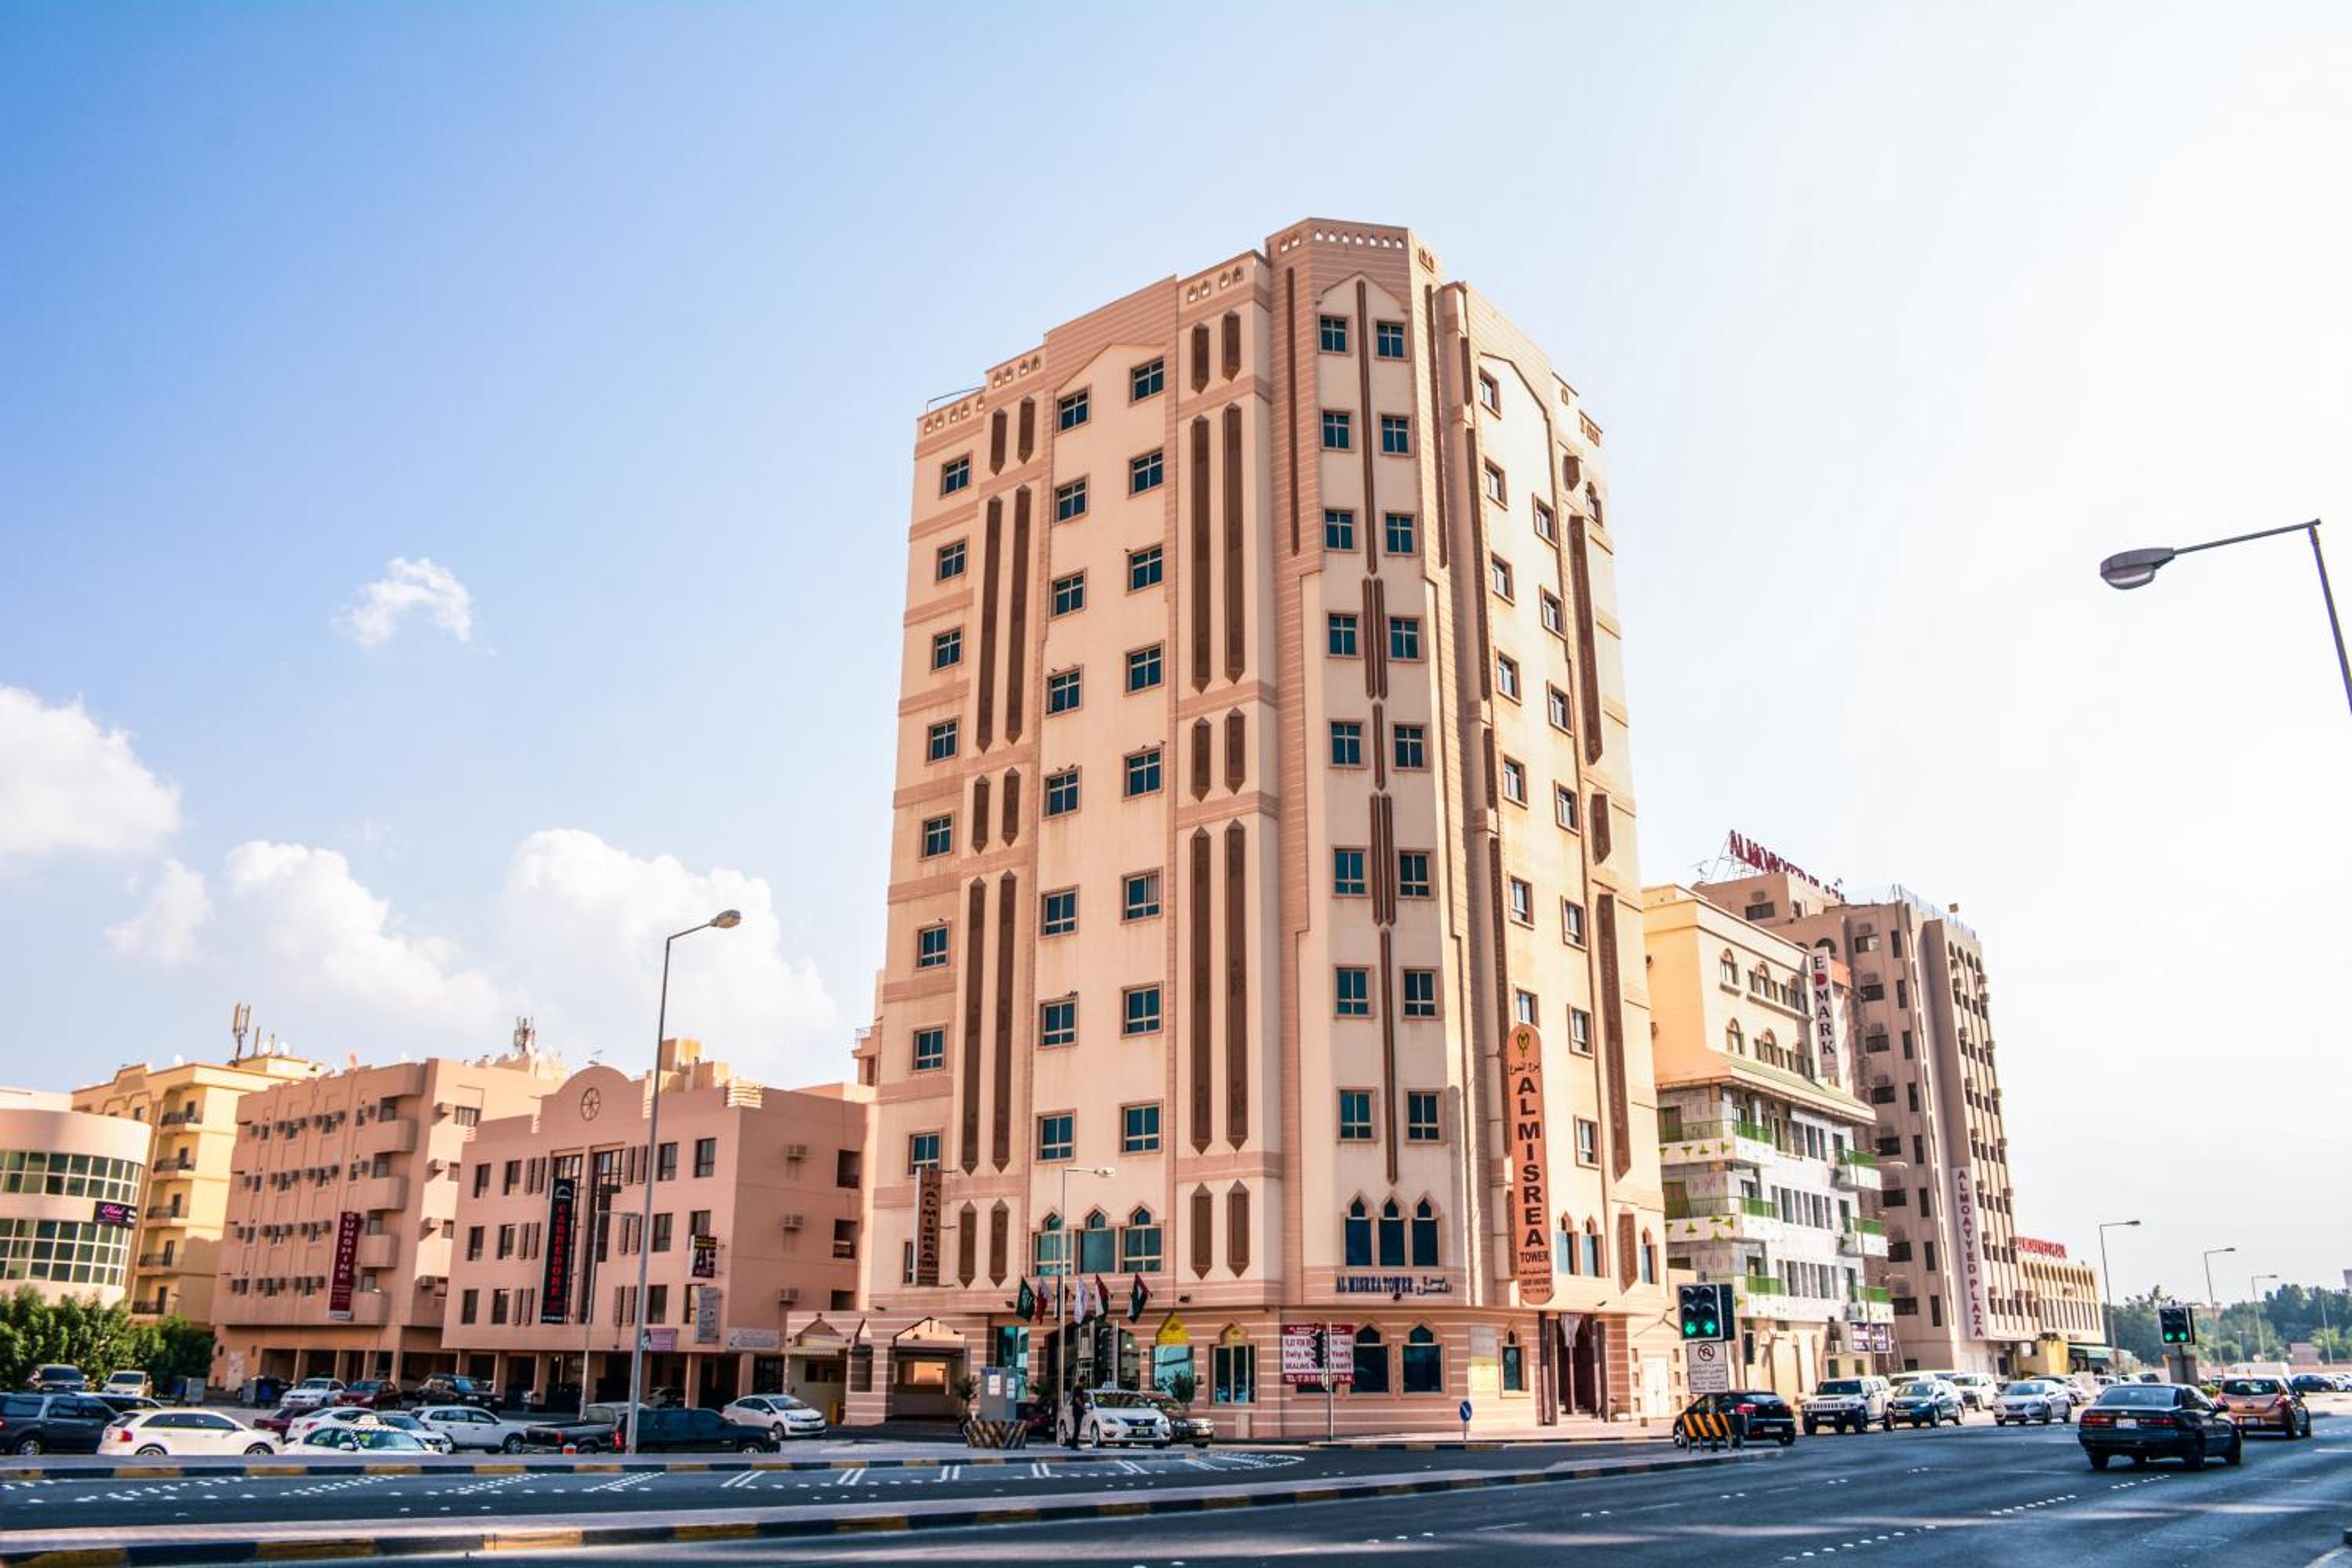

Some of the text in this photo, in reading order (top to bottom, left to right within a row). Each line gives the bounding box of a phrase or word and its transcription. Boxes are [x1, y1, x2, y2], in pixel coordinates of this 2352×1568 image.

[1813, 956, 1835, 1055] EDMARK
[339, 1212, 356, 1279] SUNSHINE
[1519, 1250, 1549, 1263] TOWER
[1957, 1171, 1983, 1337] ALMOAYYED PLAZA
